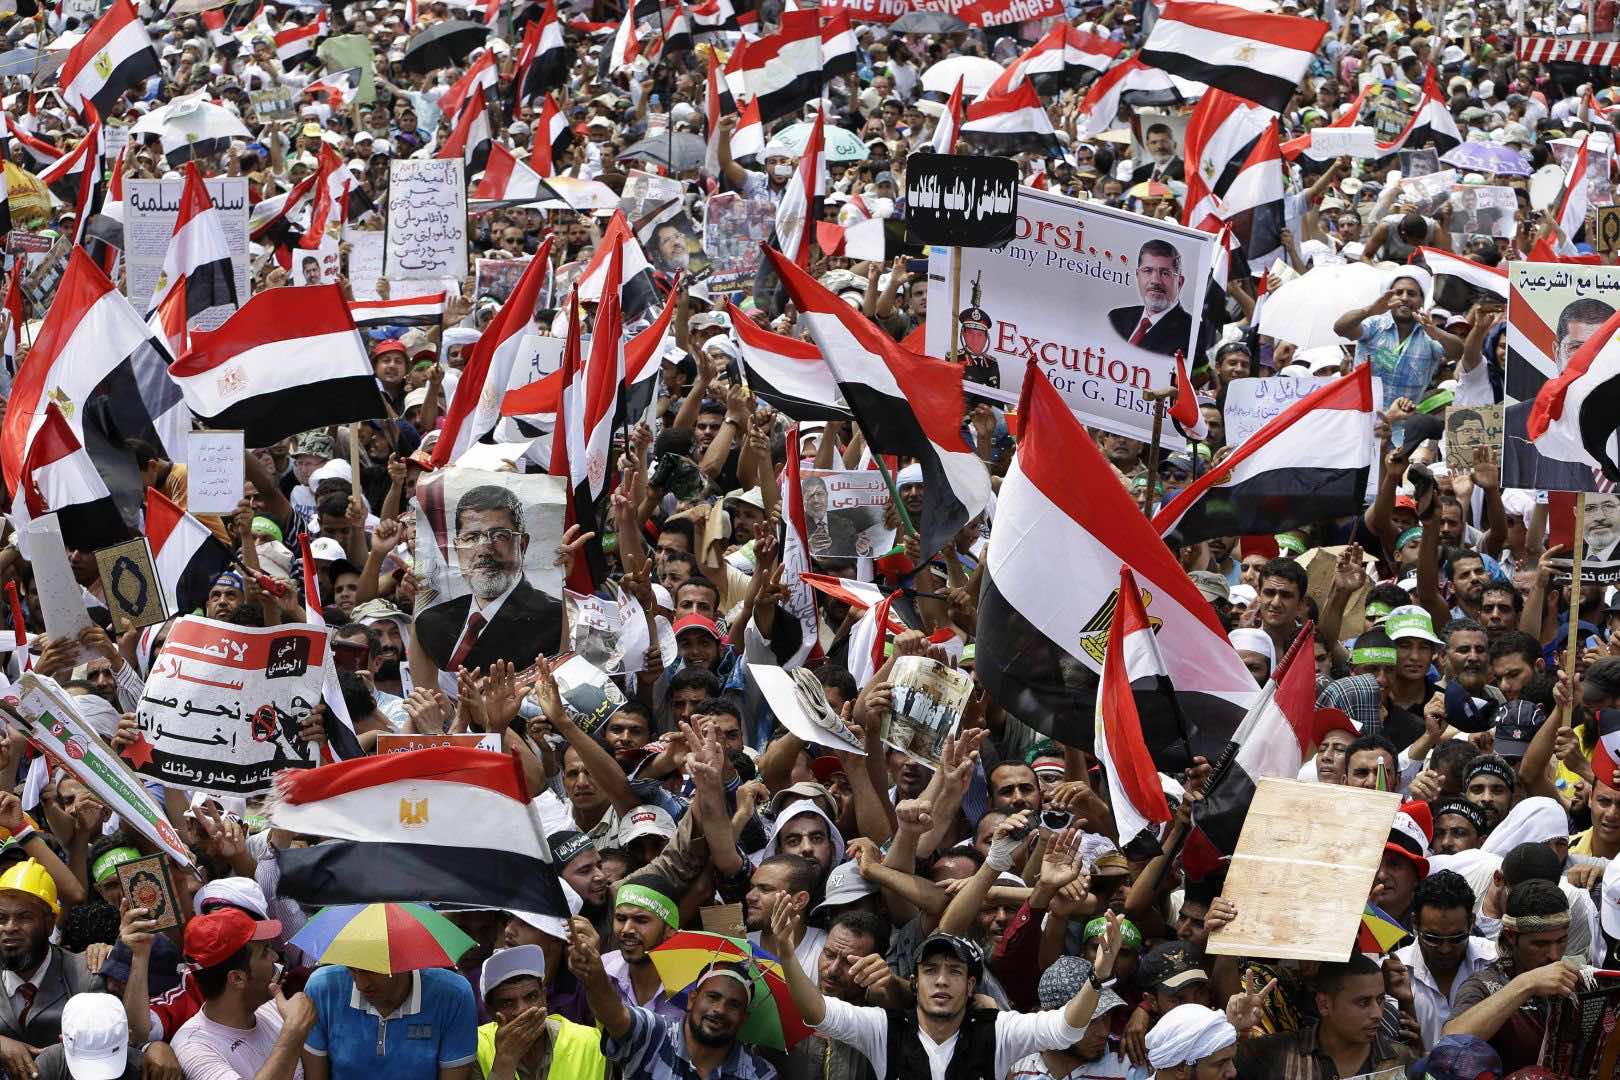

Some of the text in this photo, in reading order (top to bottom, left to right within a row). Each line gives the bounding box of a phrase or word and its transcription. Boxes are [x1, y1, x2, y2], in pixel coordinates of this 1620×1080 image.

[981, 0, 1054, 28] Brothers
[1015, 215, 1129, 266] orsi...
[1009, 246, 1039, 267] my
[1045, 249, 1131, 286] President
[1520, 270, 1573, 292] الشرعية
[994, 319, 1152, 390] Excution
[1047, 368, 1076, 393] for
[277, 638, 297, 657] أخي
[268, 659, 301, 676] الجندي
